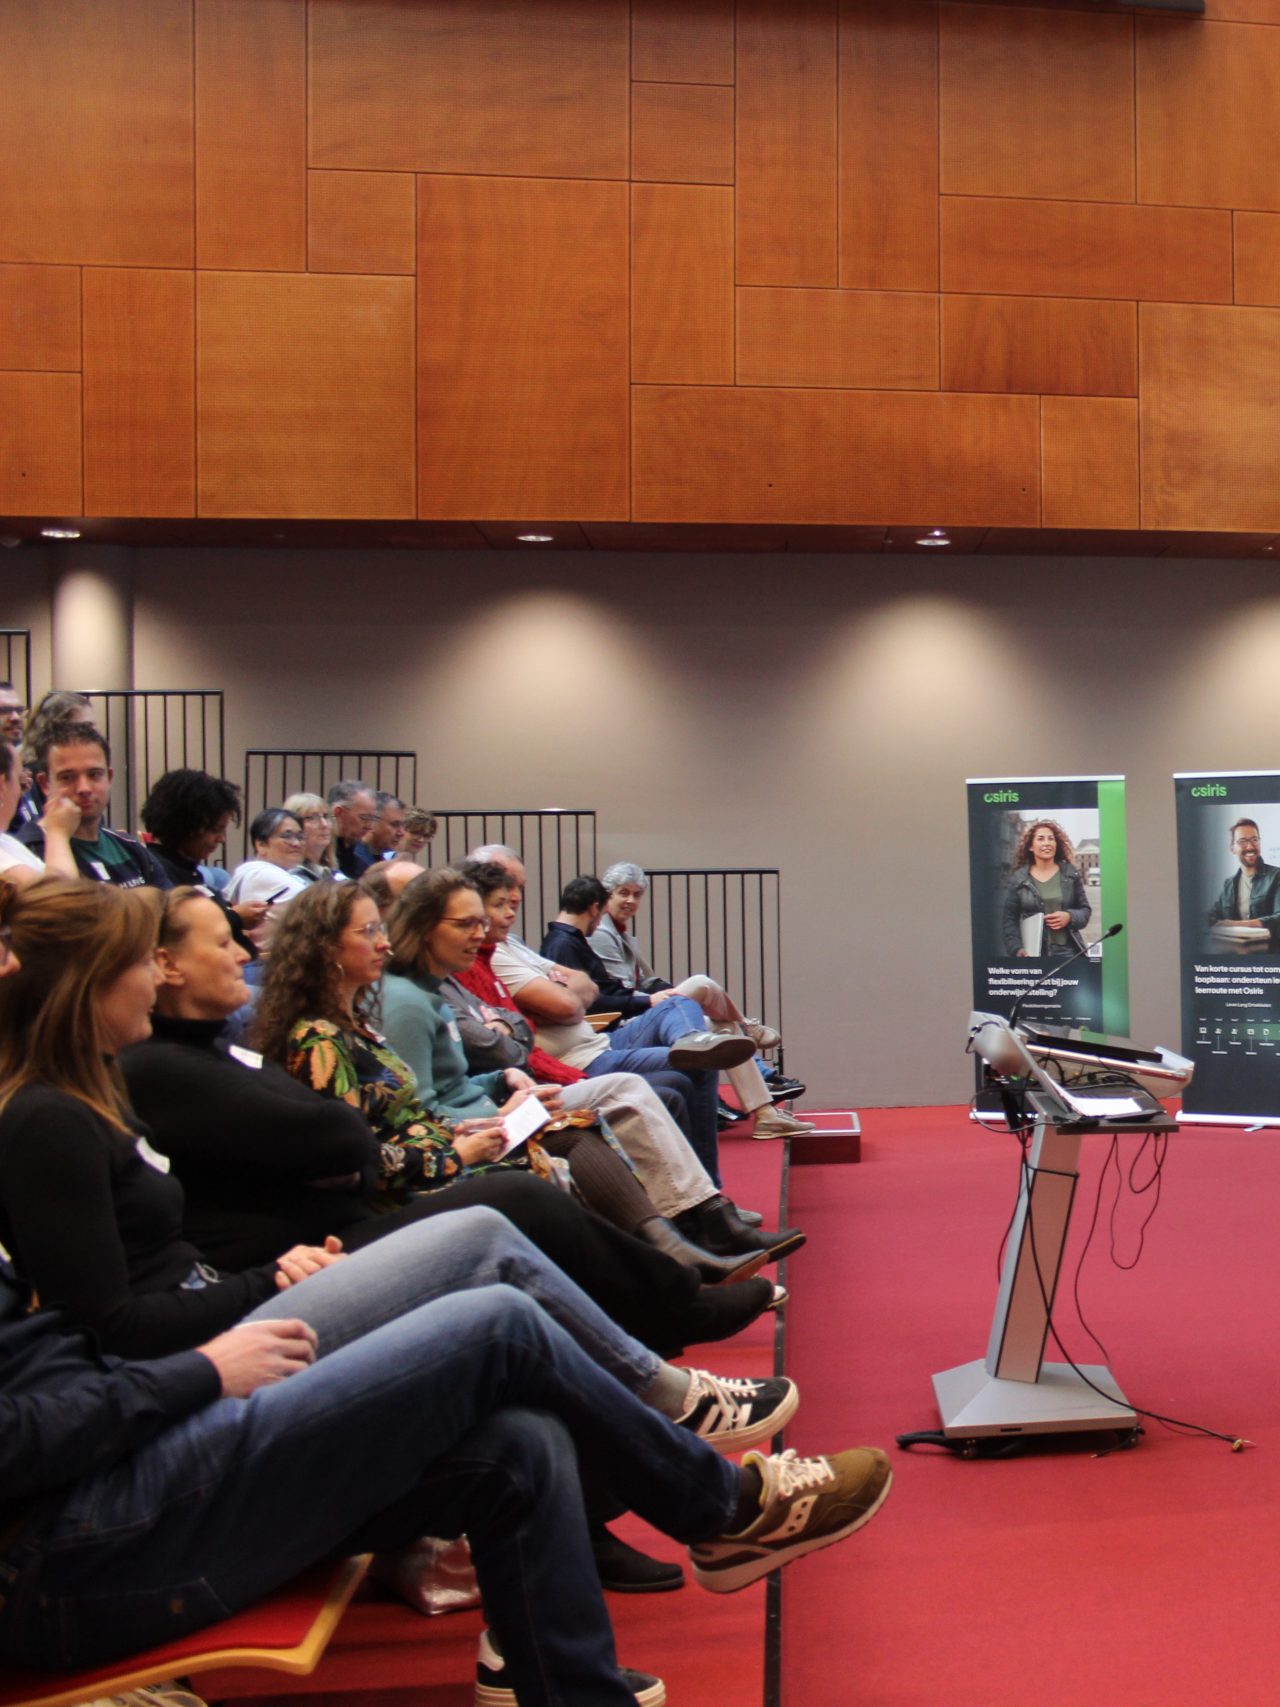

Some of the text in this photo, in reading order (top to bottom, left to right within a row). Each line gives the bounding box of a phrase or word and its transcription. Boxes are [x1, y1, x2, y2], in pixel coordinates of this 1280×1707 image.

[988, 967, 1010, 975] Welke
[1194, 964, 1209, 973] Van
[1209, 964, 1229, 973] korte
[1060, 978, 1079, 987] jouw
[1195, 976, 1231, 984] loopbaan:
[1231, 976, 1272, 984] ondersteun
[1195, 986, 1264, 995] leerroute met Osiris
